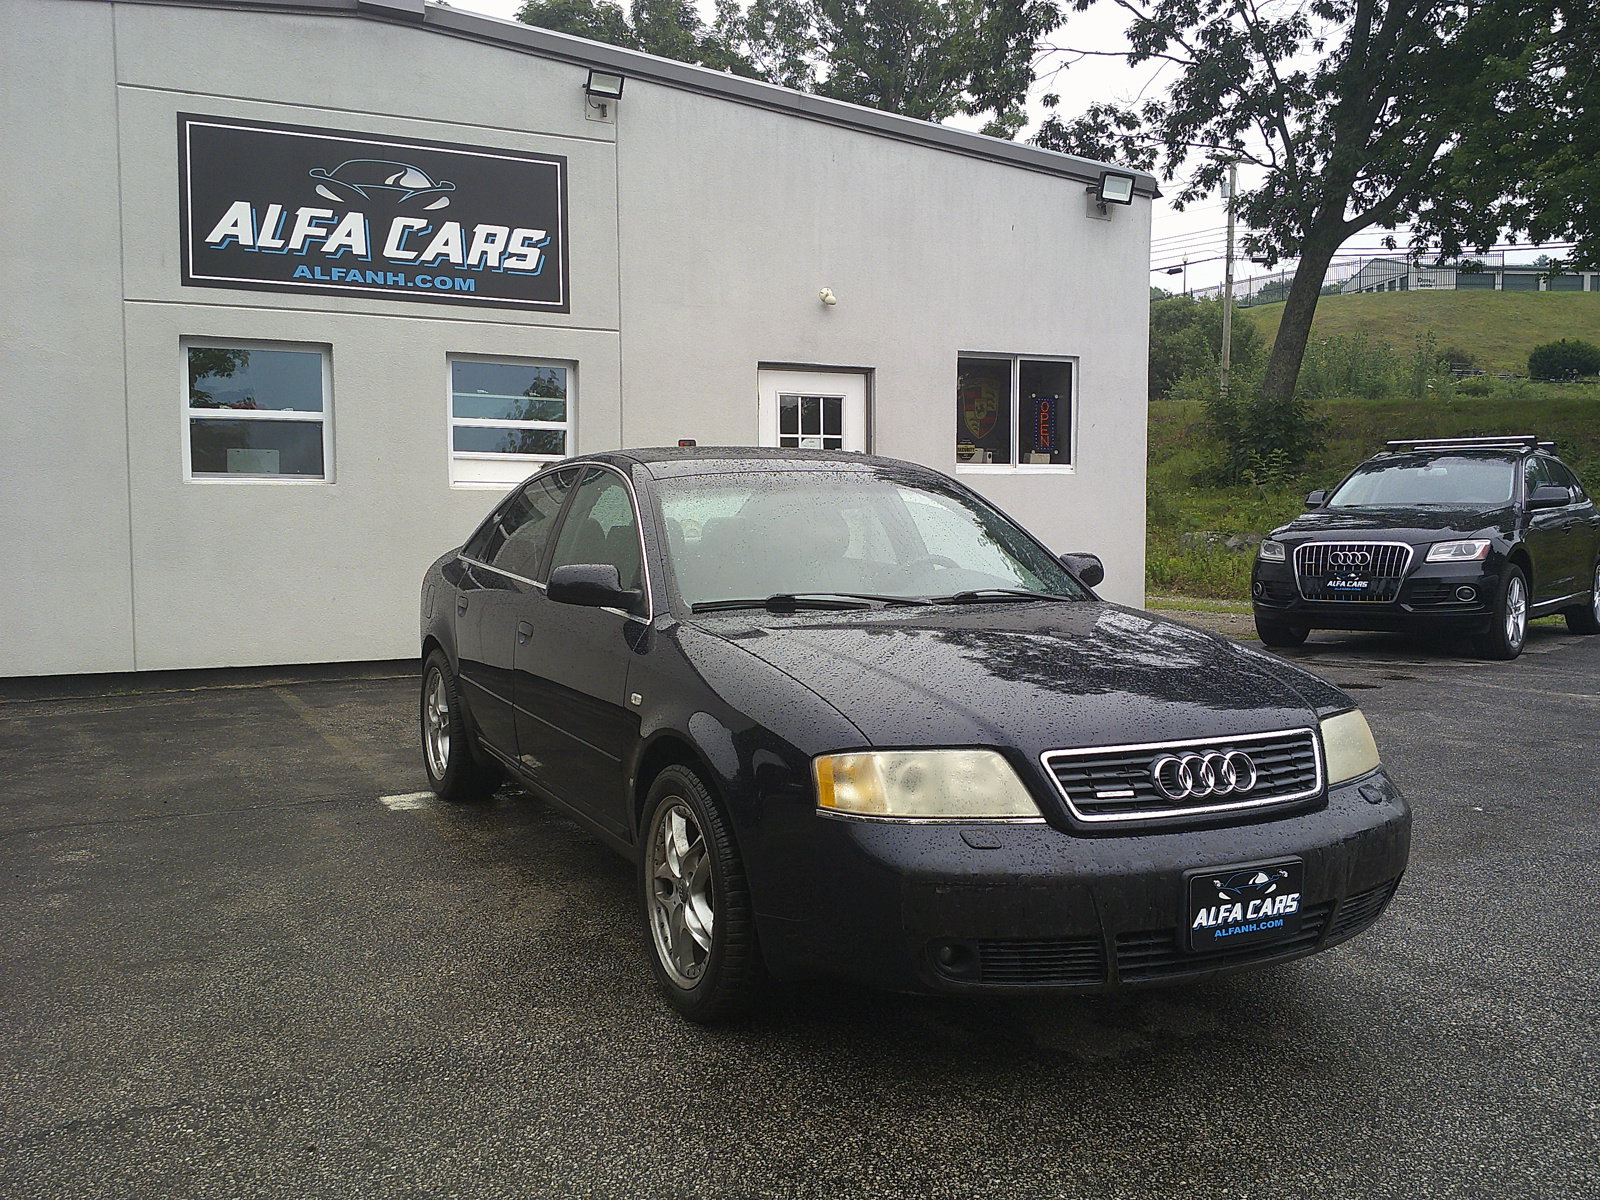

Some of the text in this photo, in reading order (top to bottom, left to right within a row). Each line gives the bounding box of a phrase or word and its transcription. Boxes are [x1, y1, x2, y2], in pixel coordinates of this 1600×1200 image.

[205, 201, 551, 276] ALFA CARS
[292, 264, 476, 292] ALFANH.COM
[1040, 401, 1050, 447] OPEN
[1326, 580, 1369, 588] ALFA CARS
[1192, 892, 1301, 930] ALFA CARS
[1214, 919, 1284, 938] ALFANH.COM
